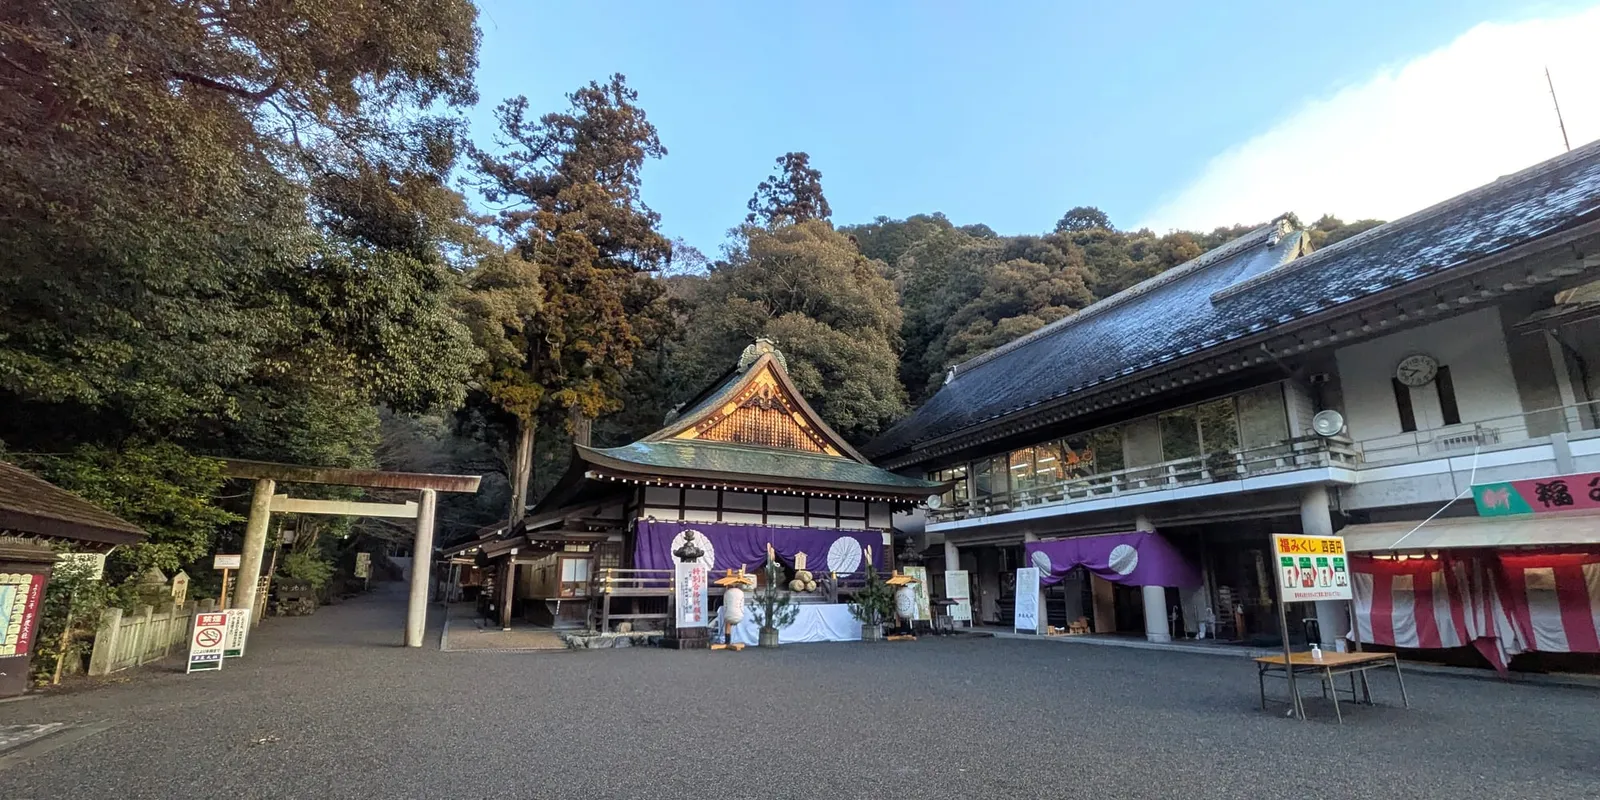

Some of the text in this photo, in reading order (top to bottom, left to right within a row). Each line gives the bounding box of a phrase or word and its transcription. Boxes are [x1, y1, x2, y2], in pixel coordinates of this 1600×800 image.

[1280, 538, 1343, 553] 福みくじ 四百円
